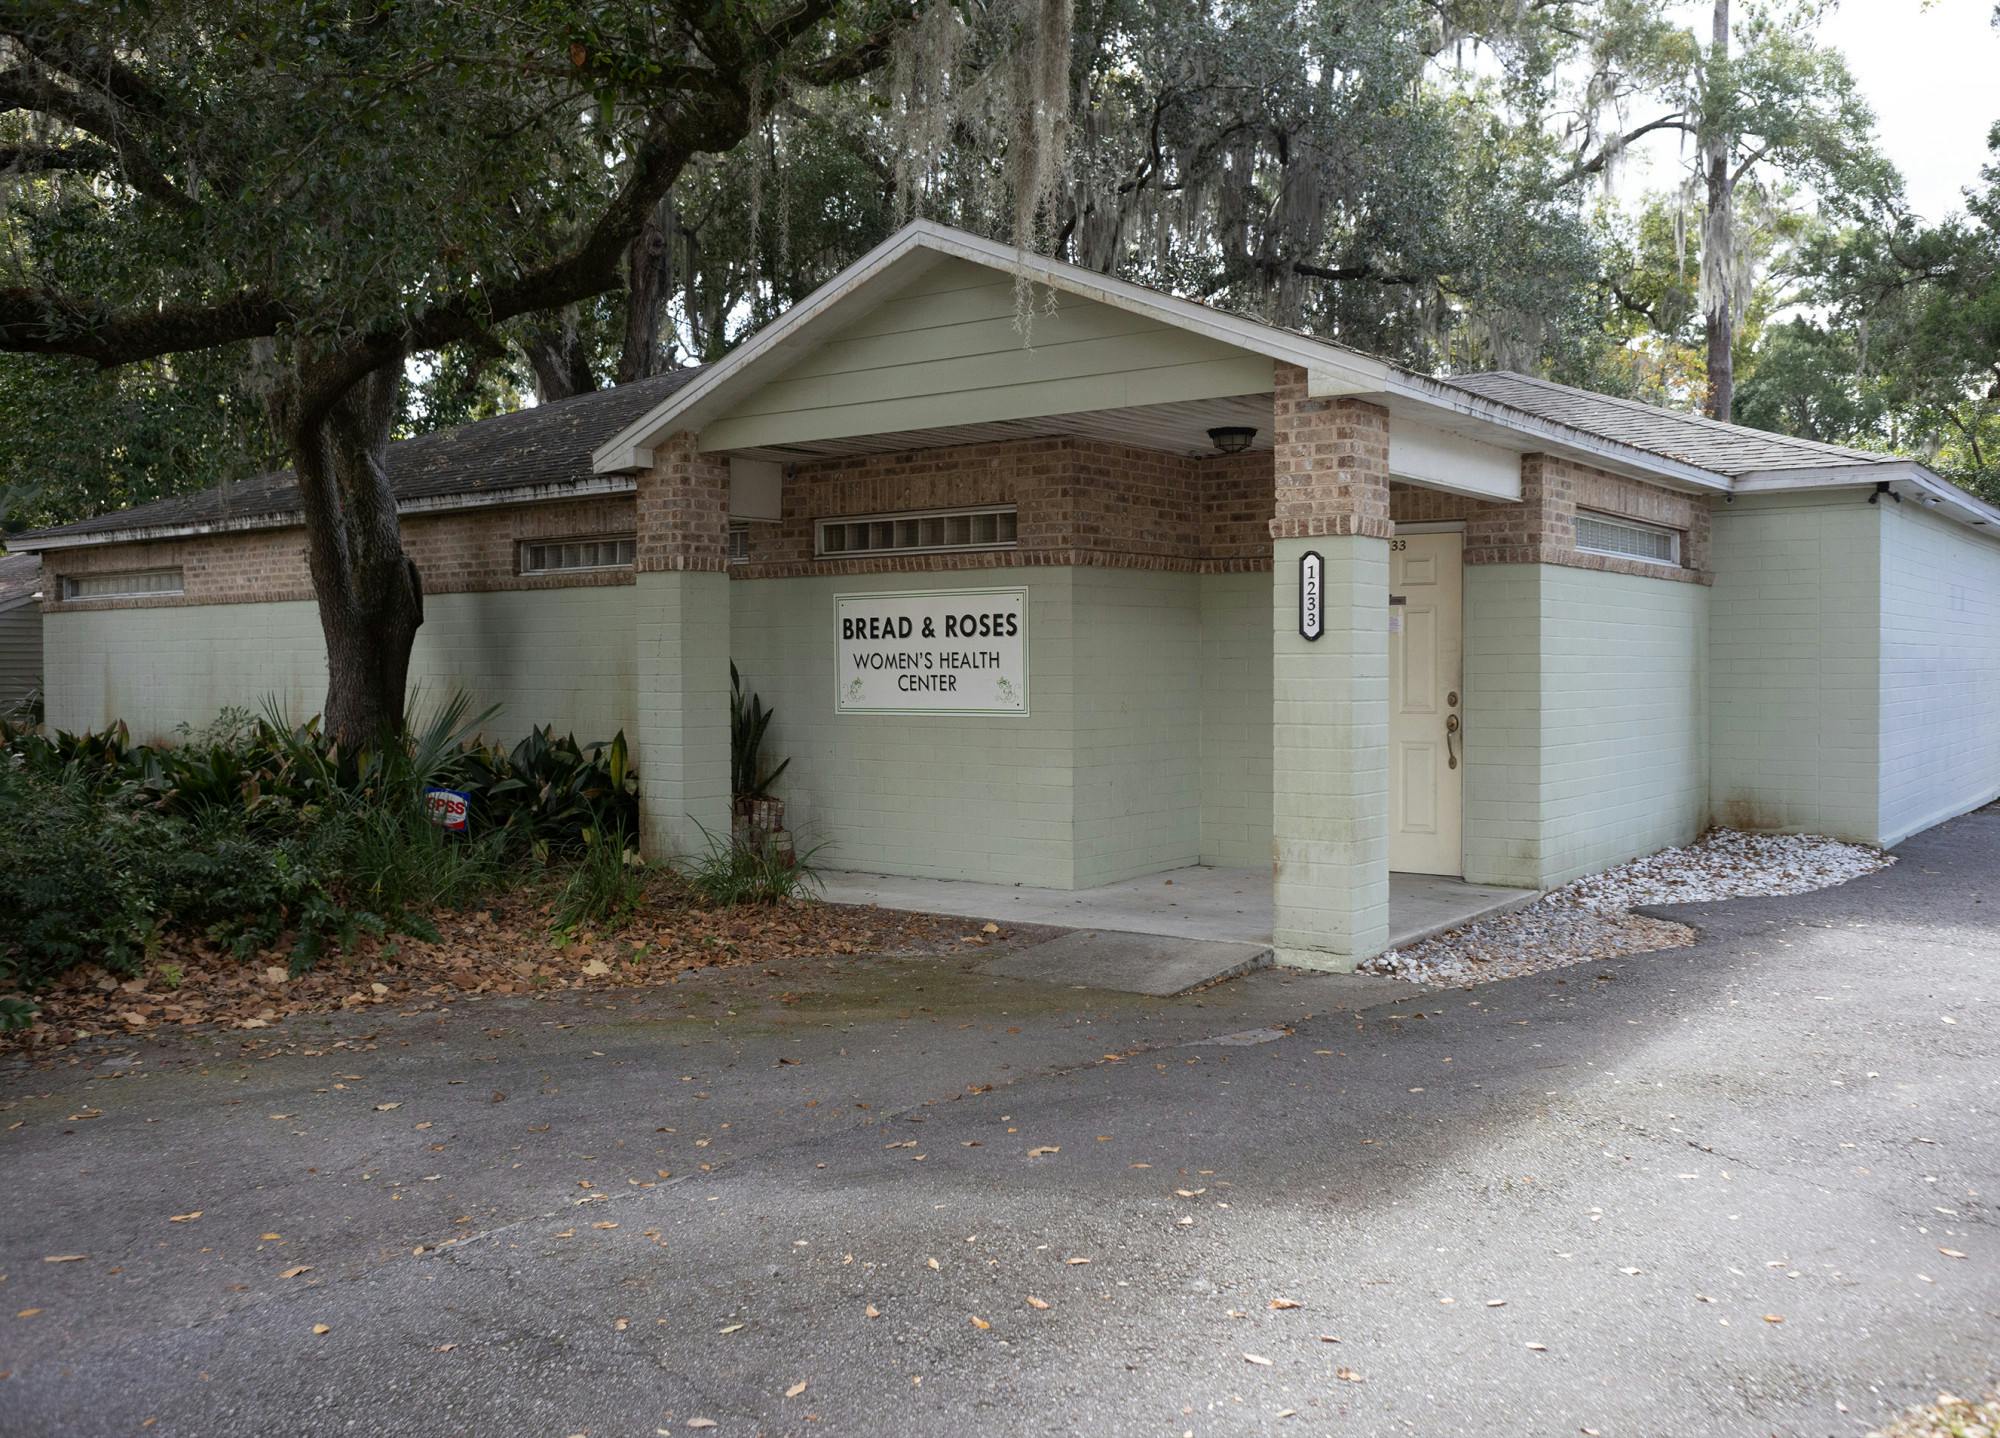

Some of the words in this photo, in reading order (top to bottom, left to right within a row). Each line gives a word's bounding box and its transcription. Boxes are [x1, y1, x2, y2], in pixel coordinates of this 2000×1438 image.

[1391, 540, 1406, 551] 33
[1307, 565, 1316, 627] 1233
[843, 617, 913, 640] BREAD
[921, 616, 936, 639] &
[945, 613, 1018, 638] ROSES
[853, 652, 933, 670] WOMEN'S
[940, 651, 1000, 669] HEALTH
[898, 674, 957, 692] CENTER
